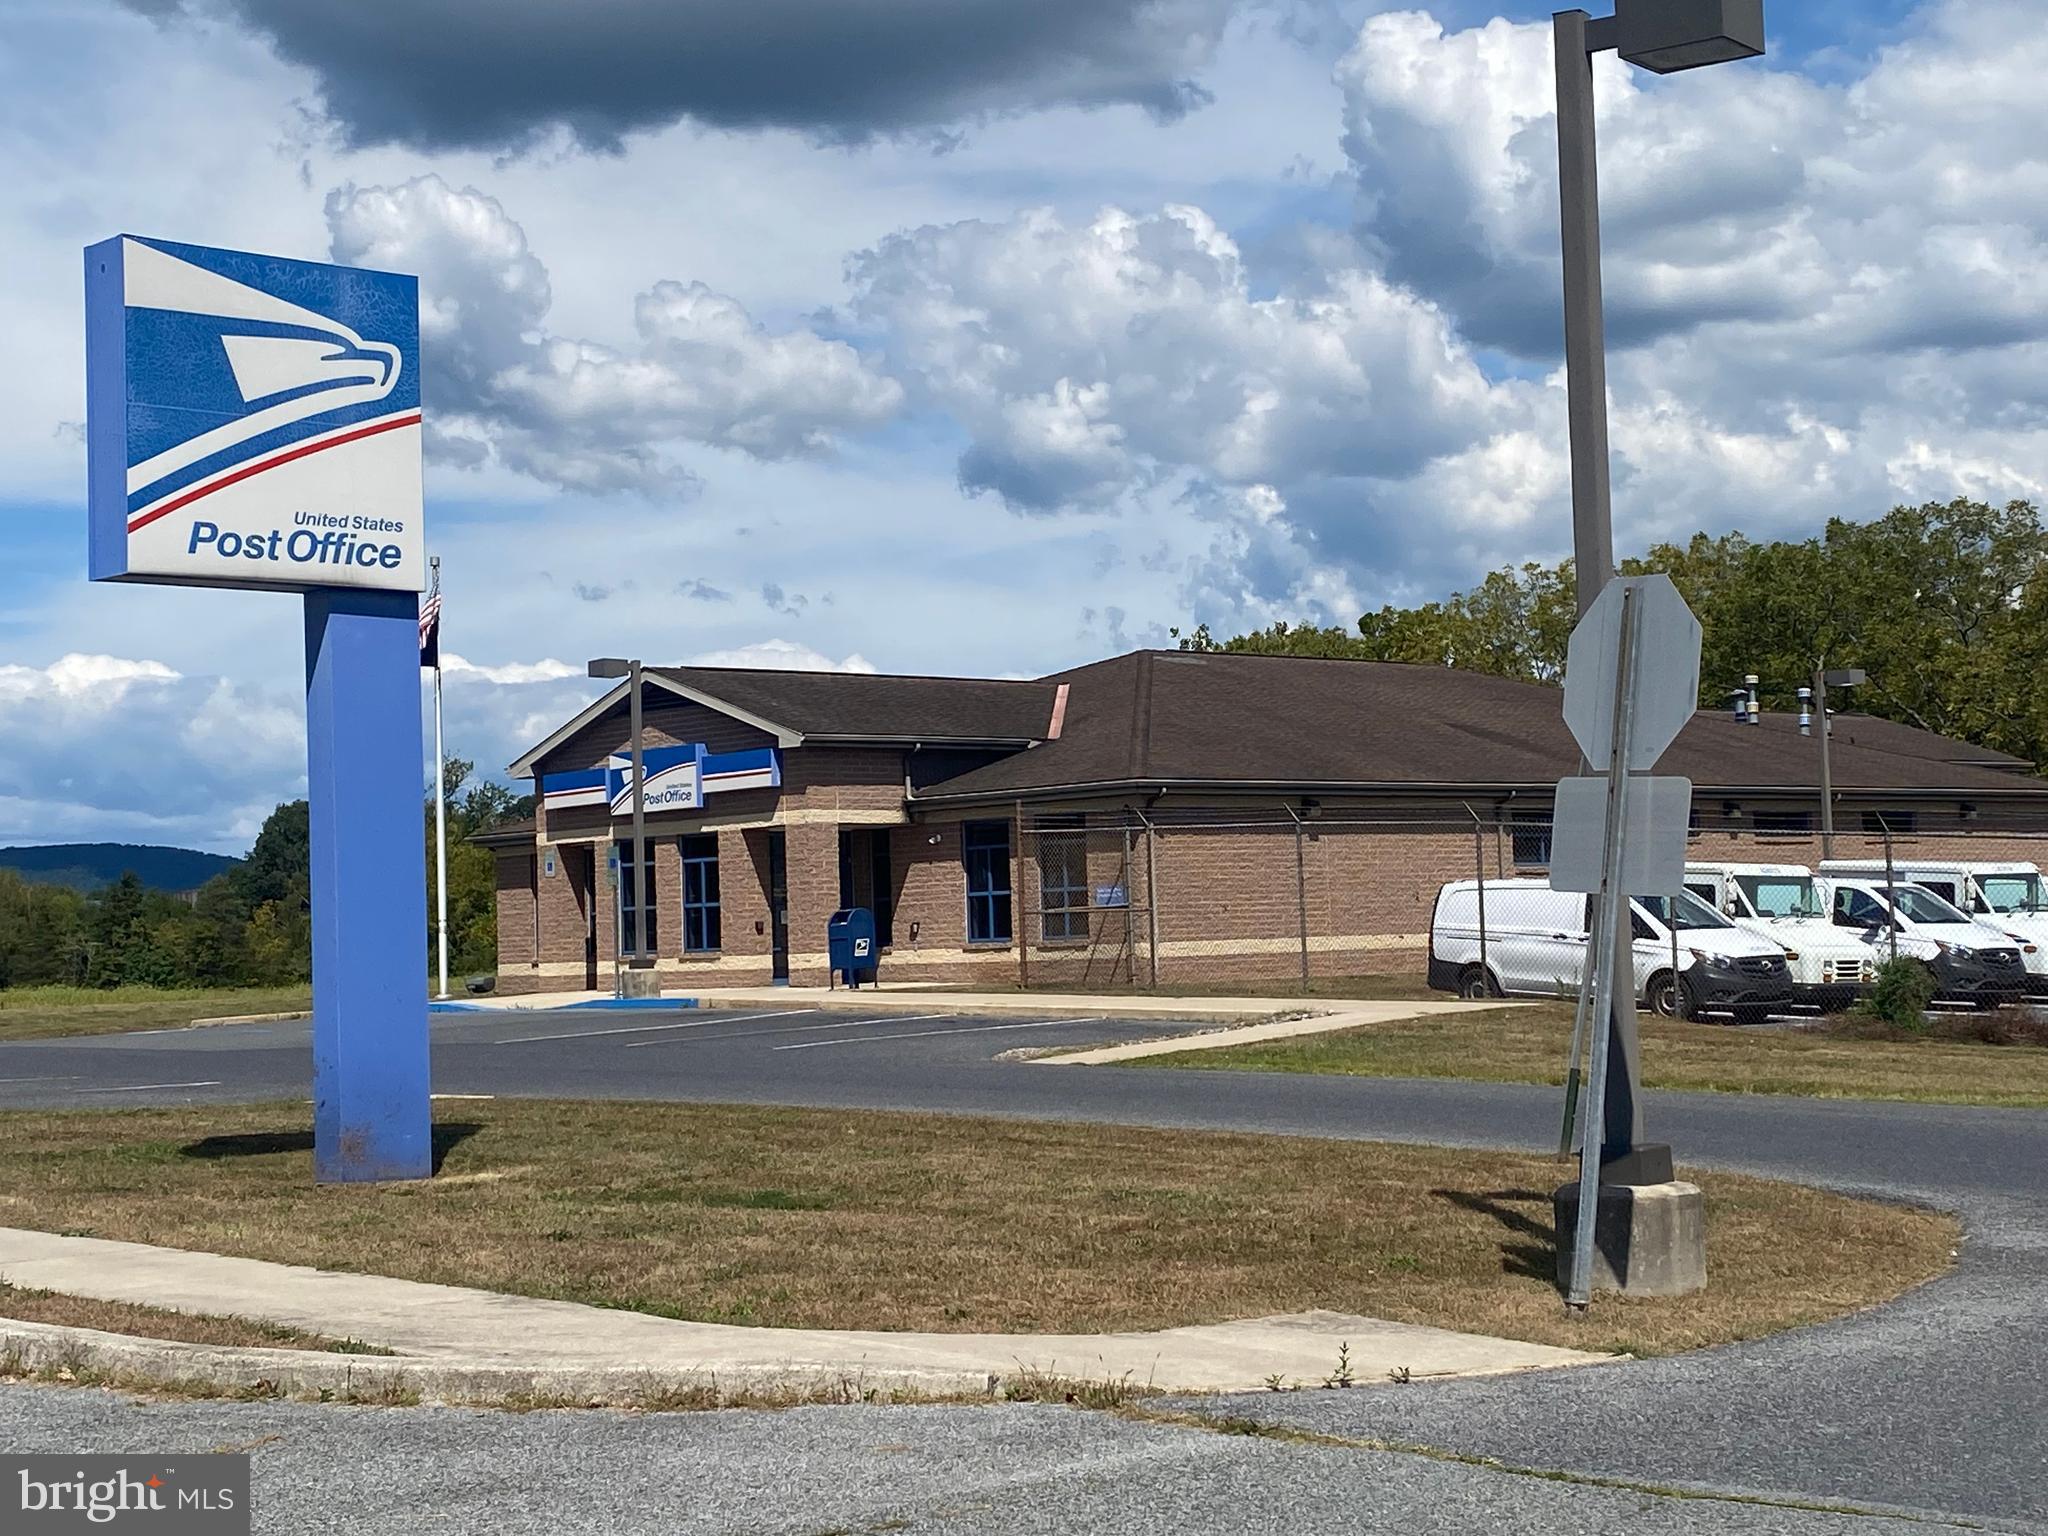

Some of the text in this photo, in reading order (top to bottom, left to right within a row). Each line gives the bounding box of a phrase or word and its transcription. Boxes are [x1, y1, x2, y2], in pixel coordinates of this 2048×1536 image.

[294, 511, 404, 533] United States
[188, 521, 402, 569] Post Office
[642, 790, 692, 805] Post Office
